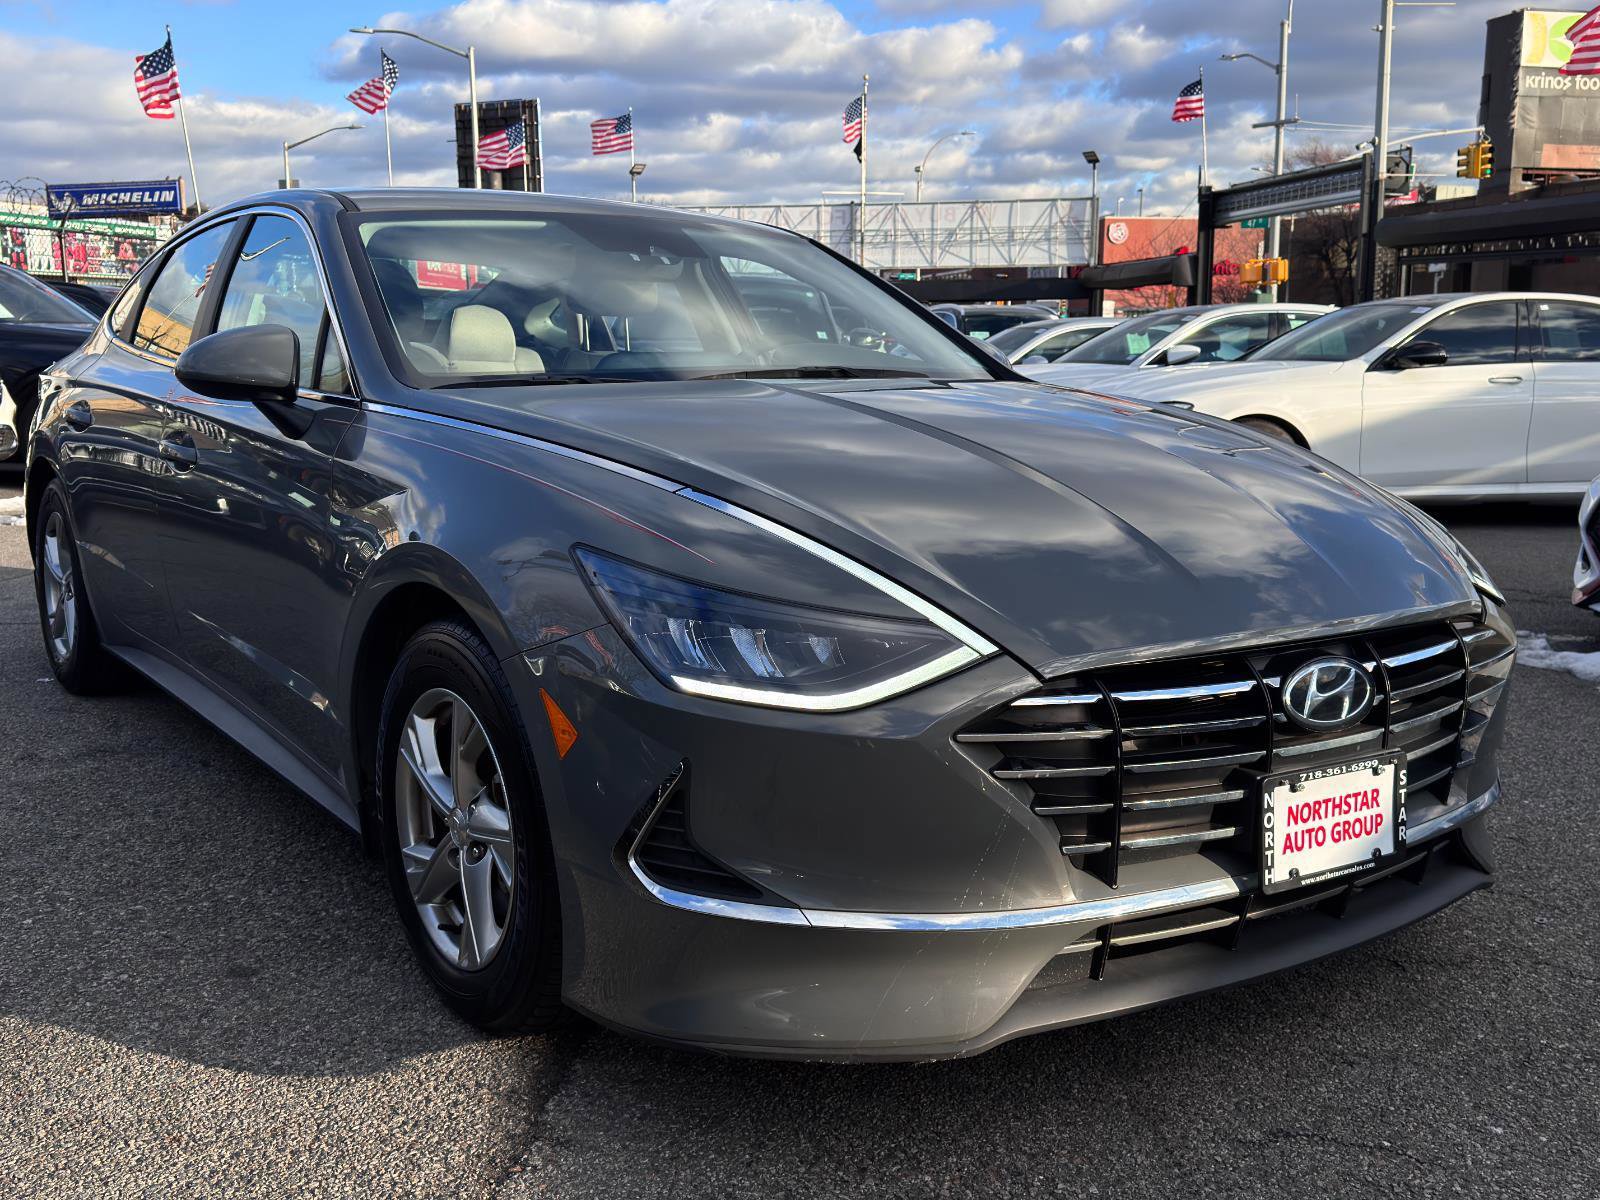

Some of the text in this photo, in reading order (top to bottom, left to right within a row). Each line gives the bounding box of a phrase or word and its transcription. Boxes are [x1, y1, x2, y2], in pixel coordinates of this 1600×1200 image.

[81, 190, 175, 205] MICHELIN
[1300, 759, 1379, 782] 718-361-6299
[1287, 788, 1380, 827] NORTHSTAR
[1398, 770, 1407, 841] STAR
[1263, 791, 1275, 886] NORTH
[1282, 813, 1384, 855] AUTO GROUP
